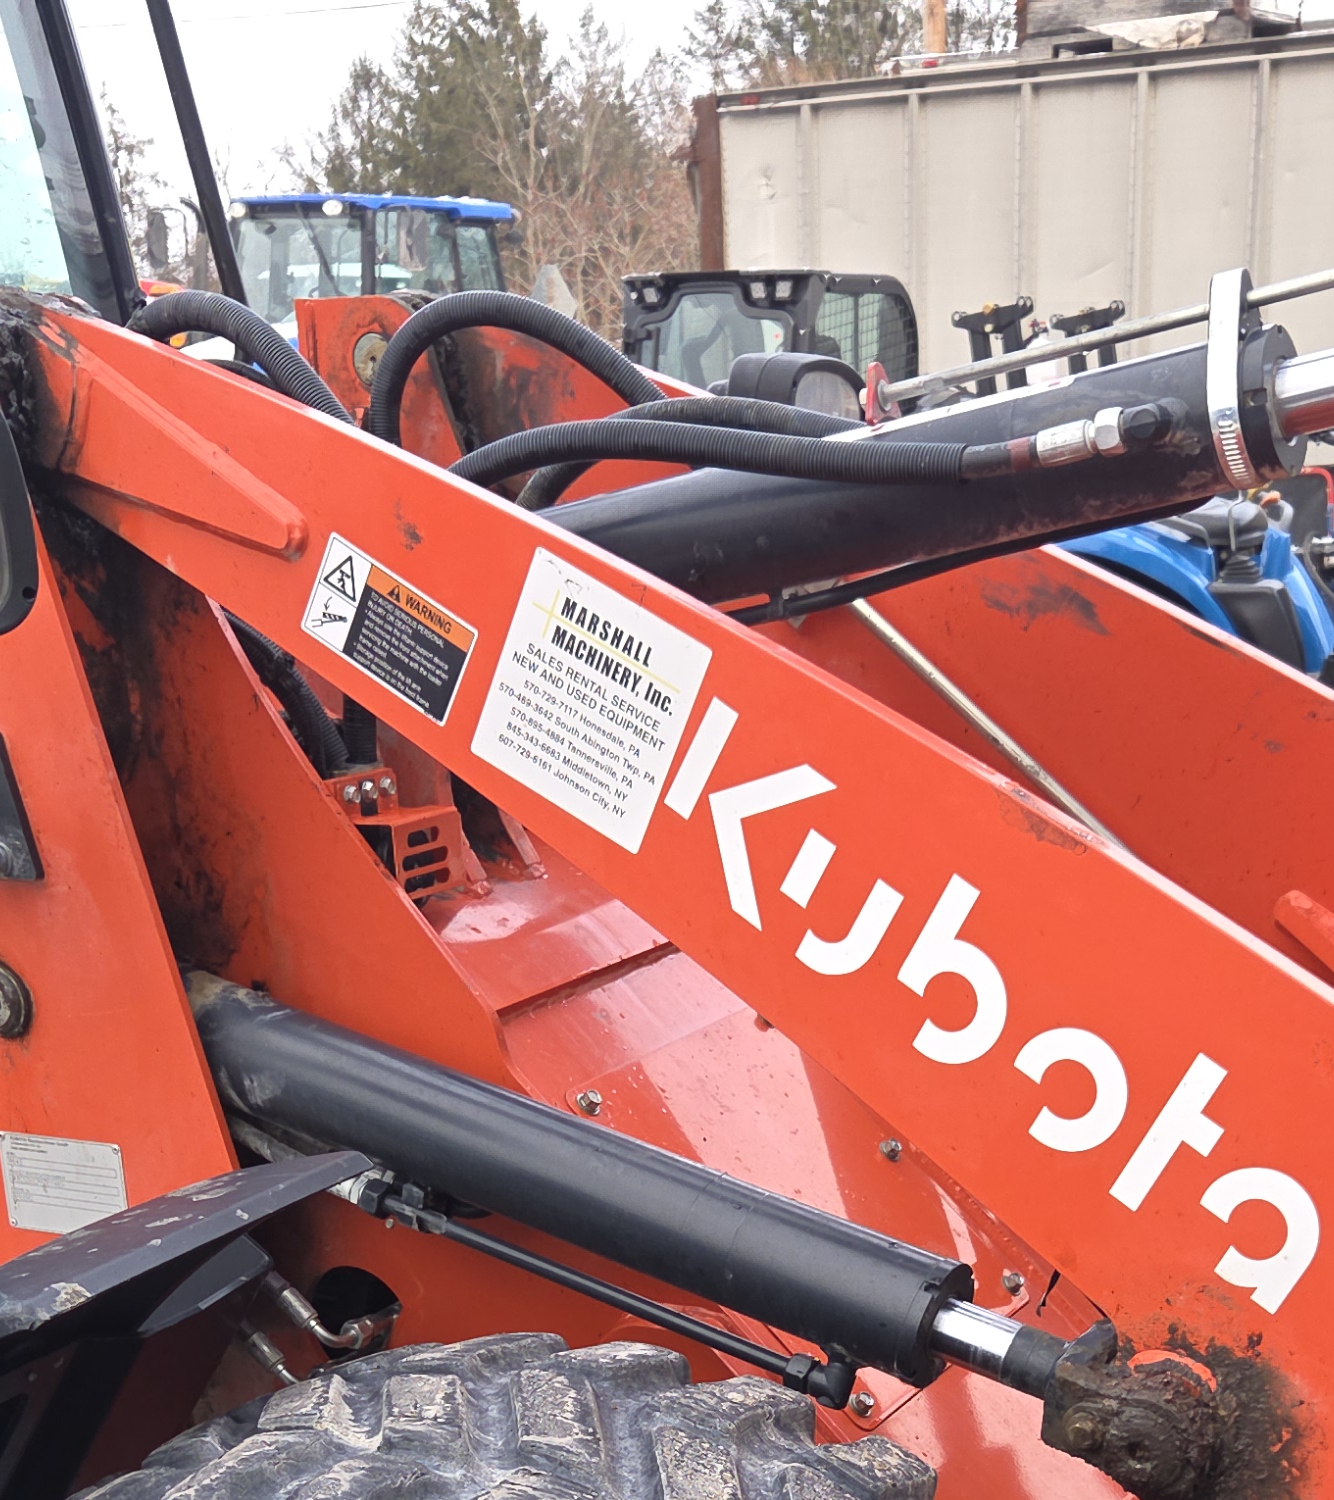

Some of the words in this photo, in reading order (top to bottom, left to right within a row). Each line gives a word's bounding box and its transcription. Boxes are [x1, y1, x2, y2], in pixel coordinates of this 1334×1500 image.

[405, 594, 452, 634] WARNING
[417, 624, 444, 648] PERSONAL
[561, 596, 652, 668] MARSHALL
[512, 651, 539, 673] NEW
[539, 669, 564, 689] AND
[567, 683, 597, 709] USED
[599, 704, 665, 751] EQUIPMENT
[527, 643, 563, 672] SALES
[565, 666, 608, 701] RENTAL
[611, 695, 660, 732] SERVICE
[551, 625, 642, 697] MACHINERY,
[644, 682, 672, 716] Inc.
[524, 680, 578, 719] 570-729-7117
[579, 714, 626, 751] Honesdale,
[628, 744, 640, 758] PA
[554, 717, 579, 738] South
[581, 733, 620, 764] Abington
[643, 771, 655, 785] PA
[553, 769, 590, 796] Johnson
[612, 805, 626, 818] NY
[562, 756, 611, 794] Middletown,
[614, 788, 628, 801] NY
[567, 740, 618, 781] Tannersville,
[621, 775, 633, 788] PA
[664, 696, 1320, 1315] Kubota
